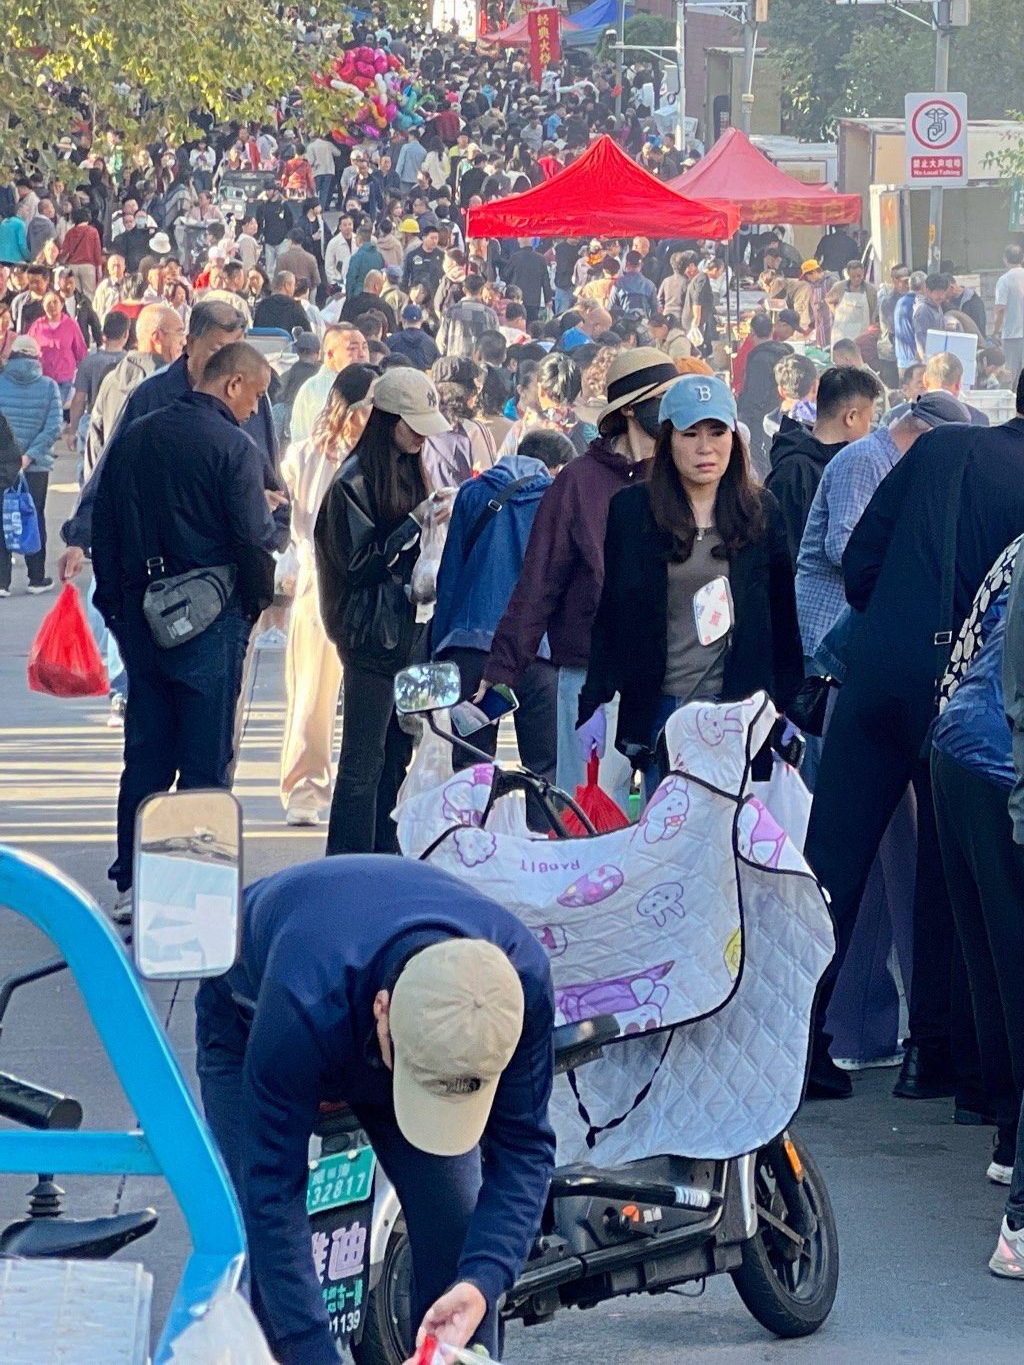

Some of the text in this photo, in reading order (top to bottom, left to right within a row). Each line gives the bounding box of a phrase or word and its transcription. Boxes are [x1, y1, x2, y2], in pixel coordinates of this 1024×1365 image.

[939, 169, 960, 177] Talking
[695, 385, 712, 402] B
[307, 1171, 366, 1207] 32817
